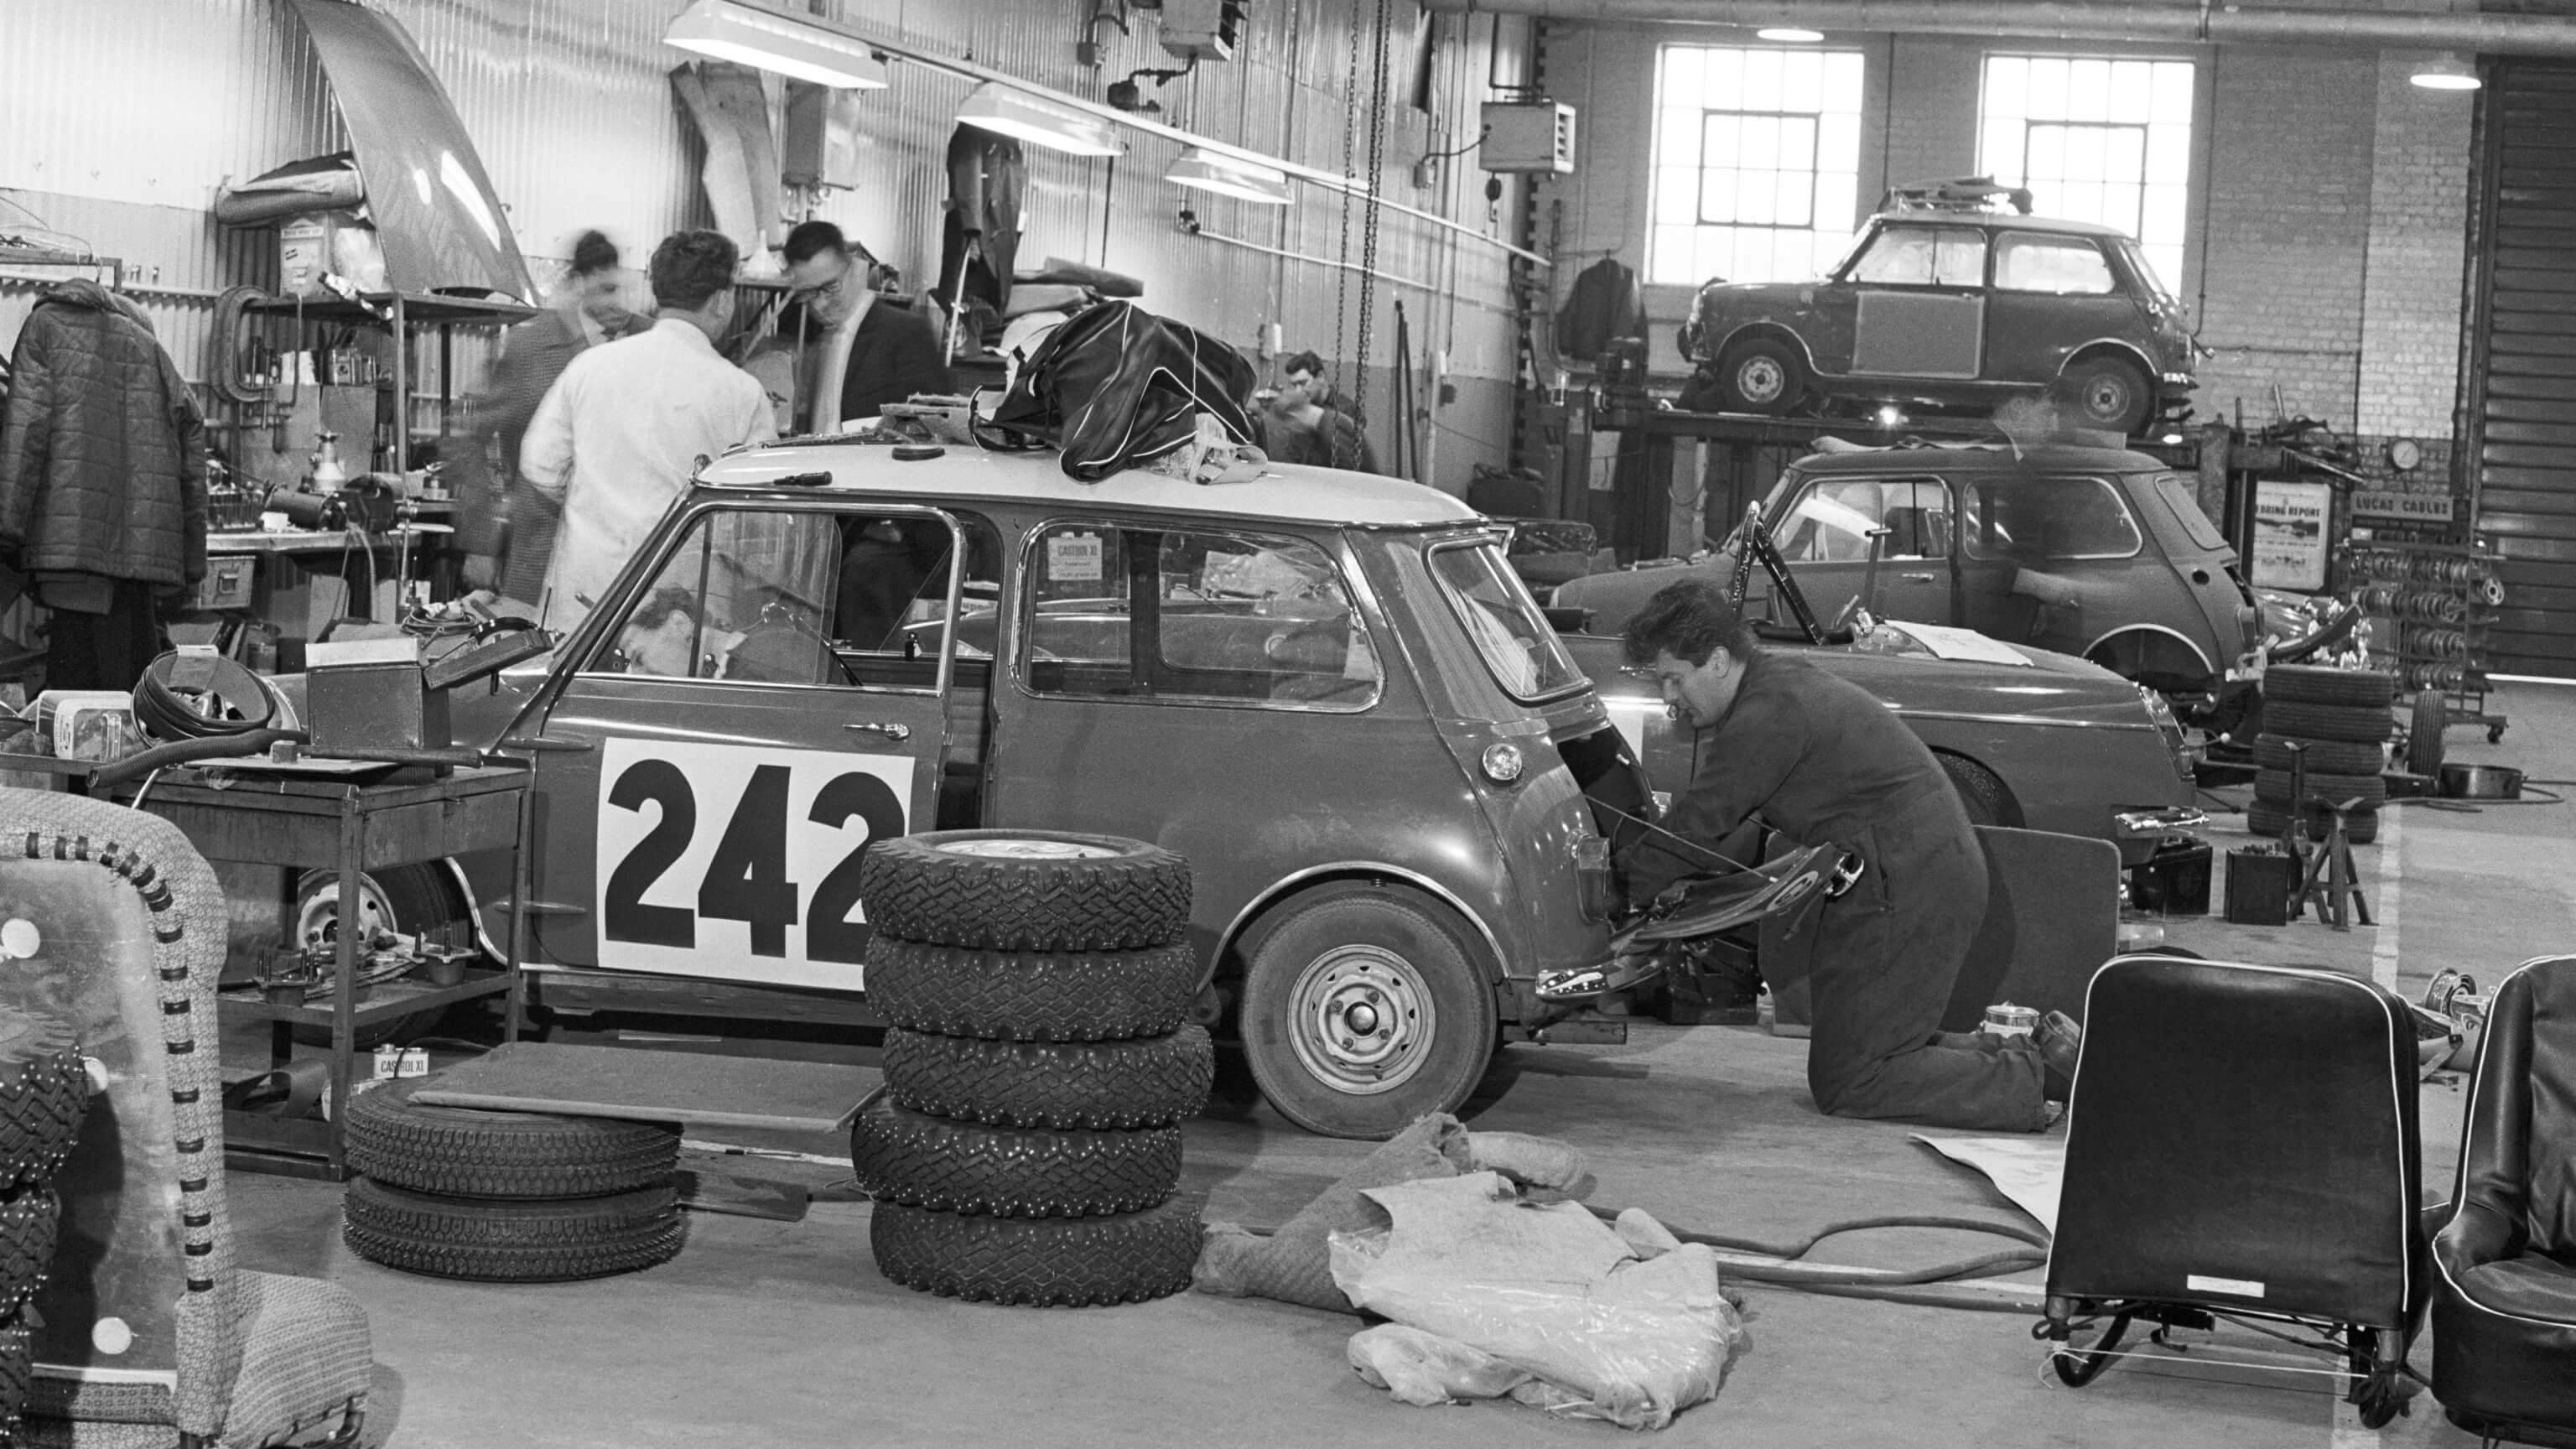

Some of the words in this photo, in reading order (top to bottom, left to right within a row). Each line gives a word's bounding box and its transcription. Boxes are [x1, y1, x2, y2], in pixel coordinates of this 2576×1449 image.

[2288, 506, 2320, 517] REPORT
[2355, 496, 2393, 512] LUCAS
[2402, 499, 2448, 514] CABLES
[605, 759, 906, 966] 242
[381, 1059, 414, 1073] CASROL
